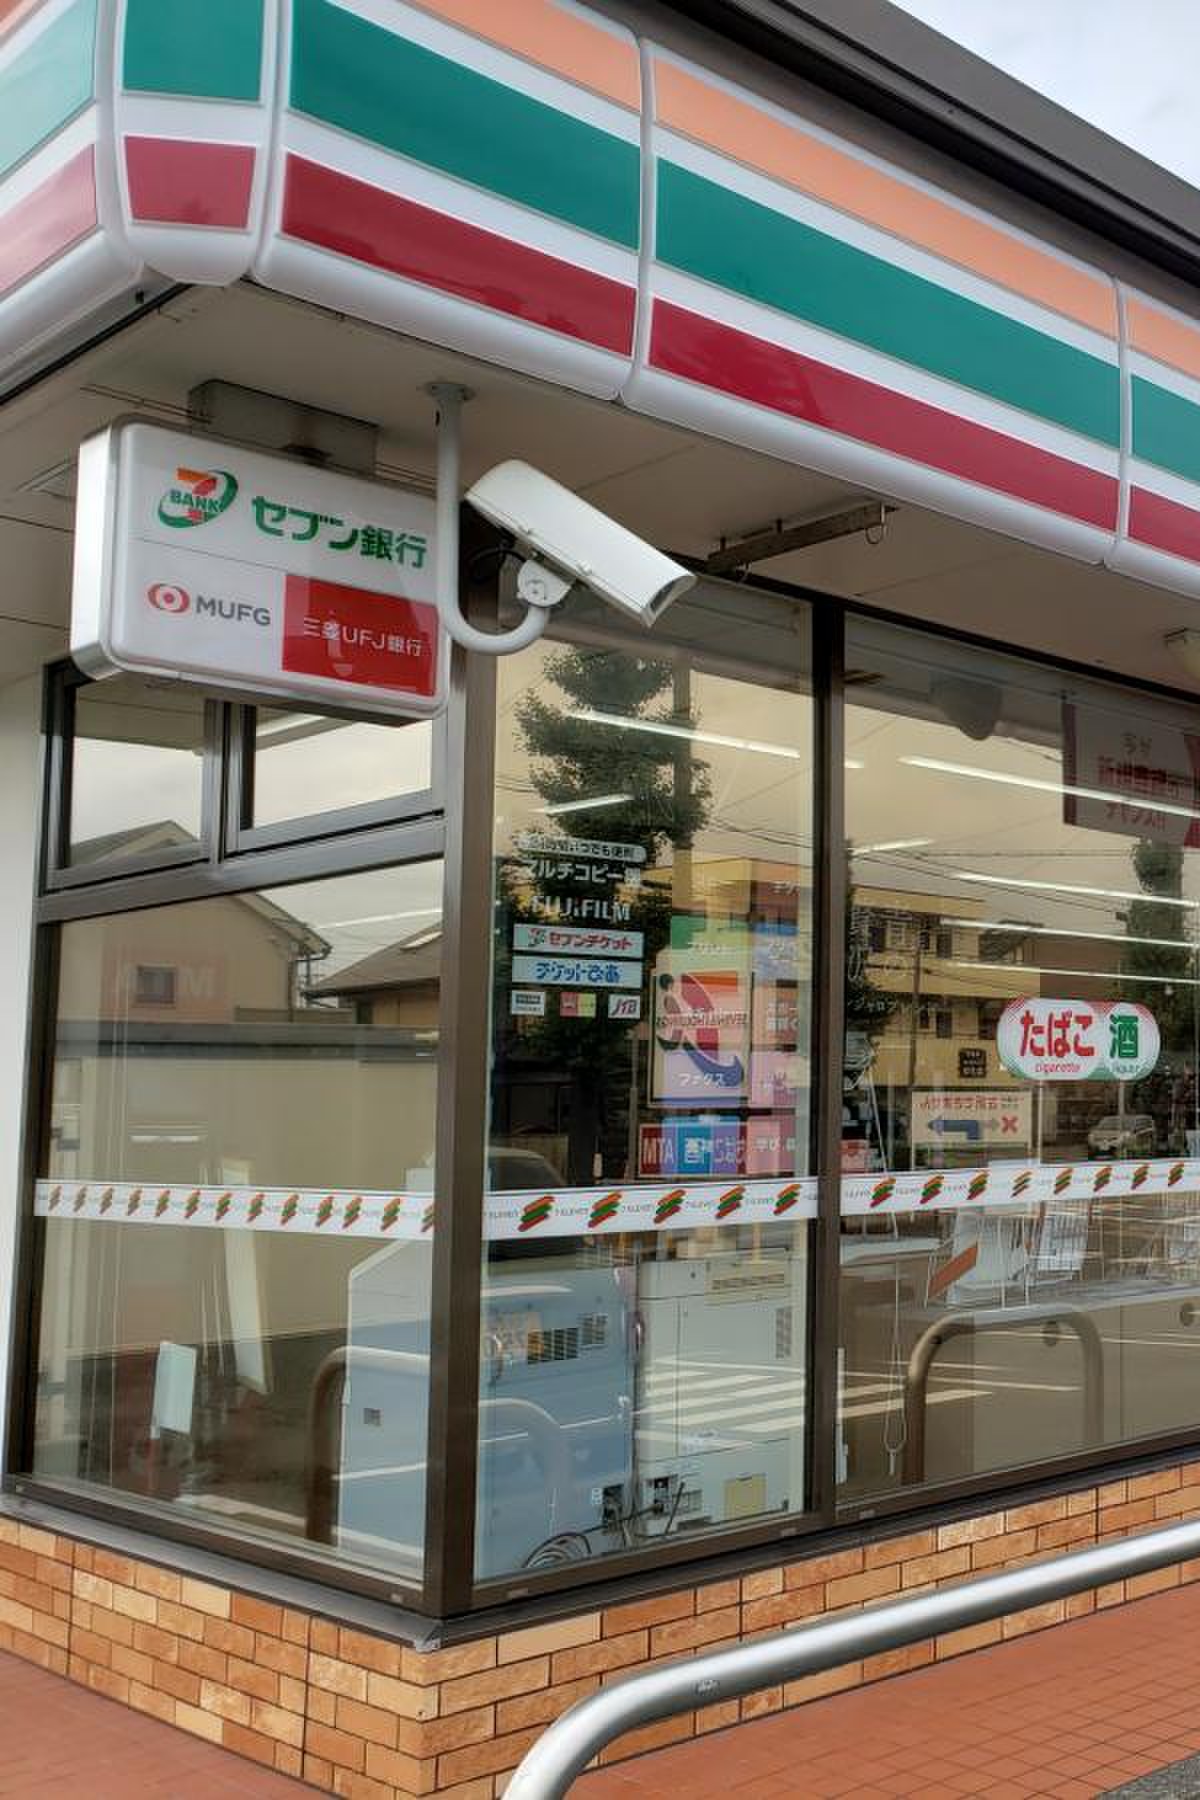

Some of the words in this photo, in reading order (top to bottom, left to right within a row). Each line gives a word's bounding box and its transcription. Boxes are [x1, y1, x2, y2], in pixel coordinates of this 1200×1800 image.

[169, 488, 219, 513] BANK
[251, 495, 427, 569] セブン銀行
[196, 595, 272, 626] MUFG
[549, 931, 633, 951] セブンチケット
[534, 960, 622, 984] チケットぴあ
[1019, 1010, 1095, 1058] たばこ
[1109, 1013, 1139, 1058] 酒
